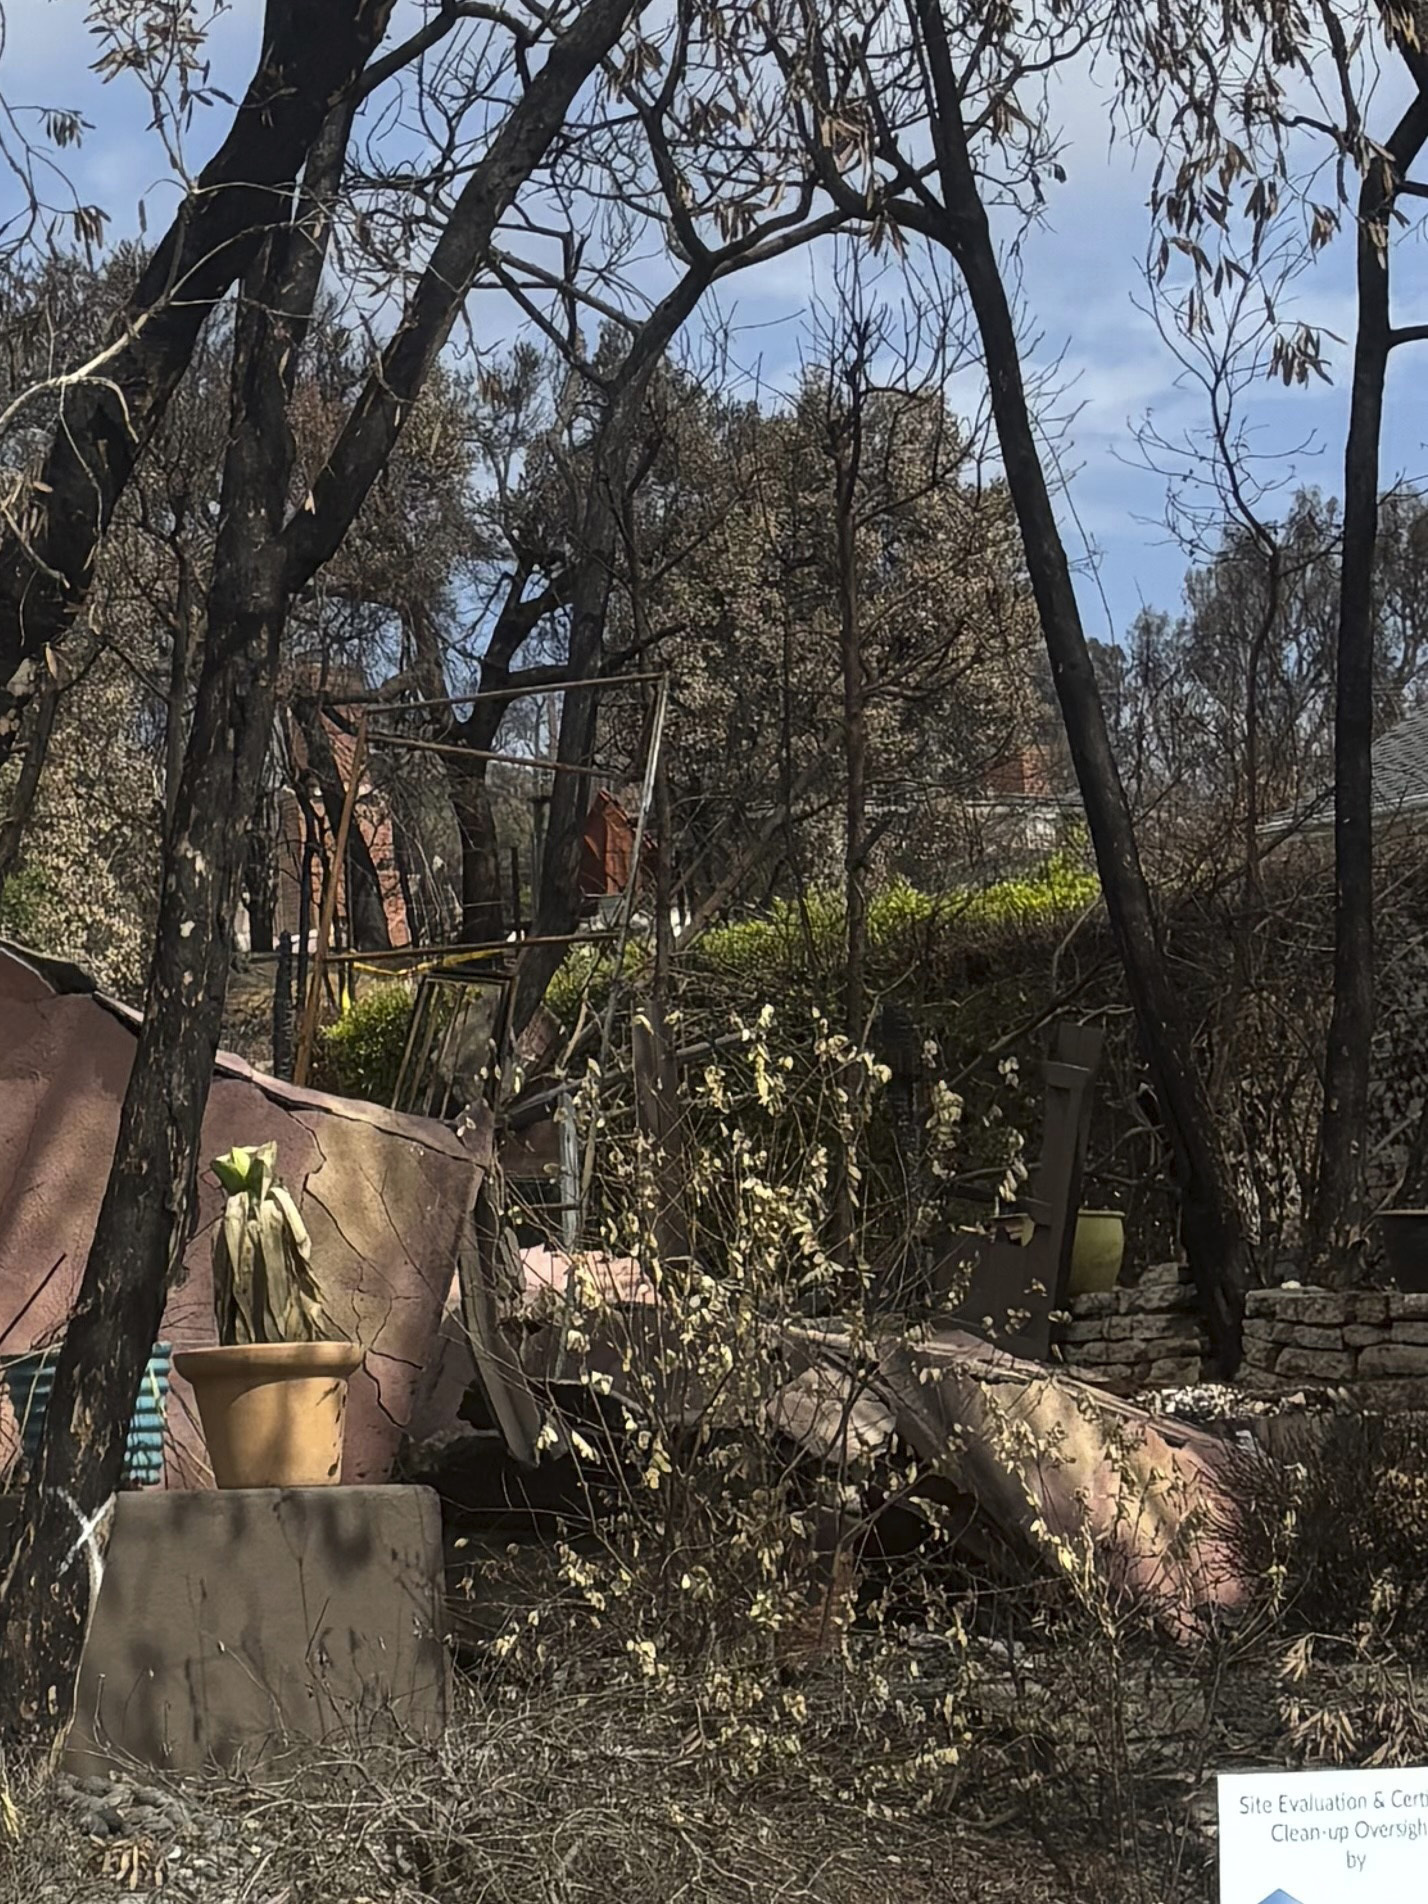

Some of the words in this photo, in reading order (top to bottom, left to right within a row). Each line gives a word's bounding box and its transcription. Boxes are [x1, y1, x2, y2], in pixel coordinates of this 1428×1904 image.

[1240, 1795, 1272, 1814] Site
[1279, 1793, 1367, 1813] Evaluation
[1373, 1791, 1385, 1809] &
[1271, 1824, 1349, 1843] Clean-up
[1346, 1850, 1366, 1872] by
